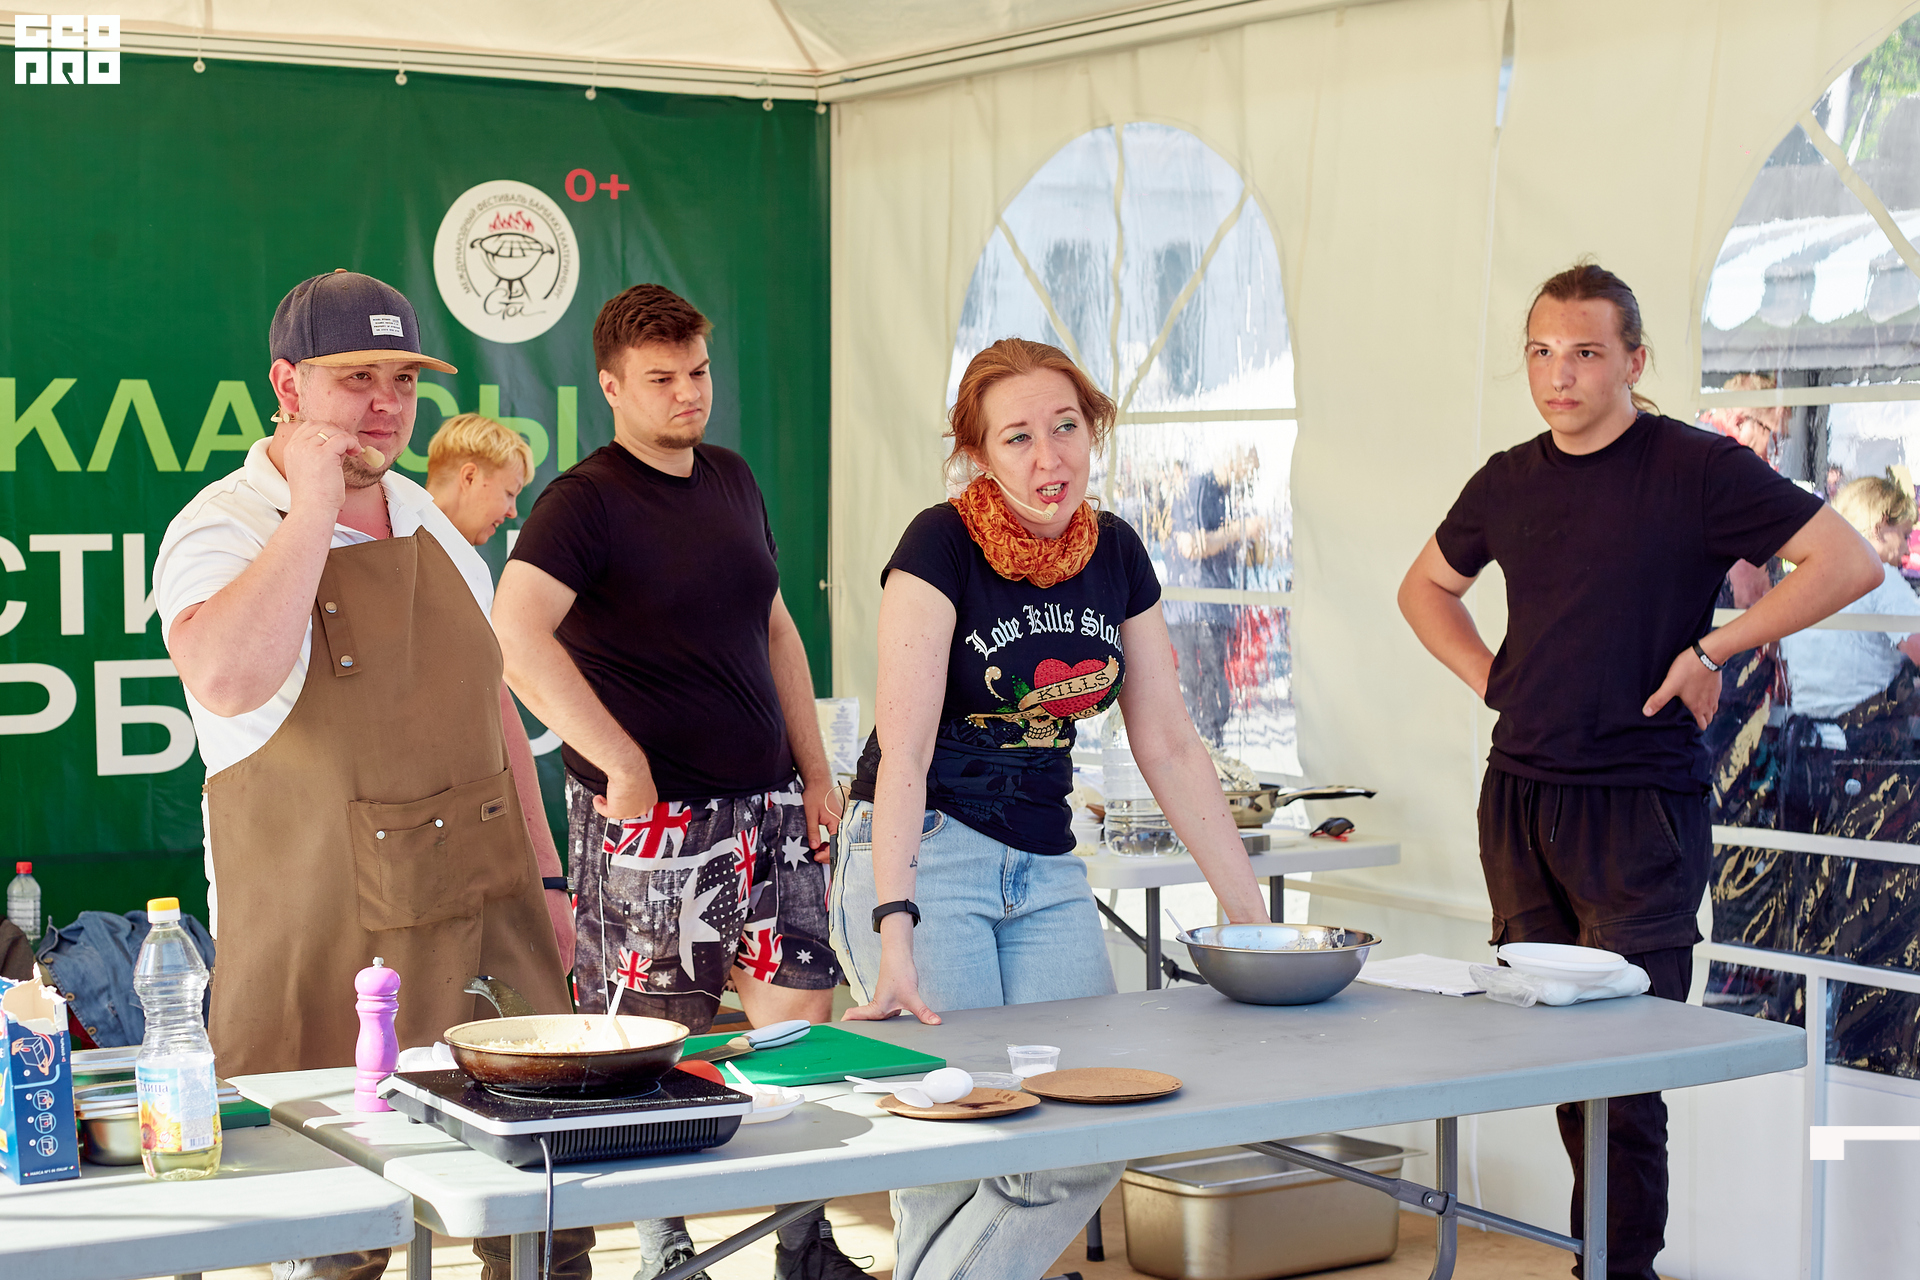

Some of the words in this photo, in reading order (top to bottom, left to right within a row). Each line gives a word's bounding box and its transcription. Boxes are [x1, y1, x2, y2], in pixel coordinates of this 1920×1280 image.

[565, 168, 630, 203] 0+
[476, 193, 528, 212] ФЕСТИВАЛЬ
[965, 616, 1024, 661] Love
[1022, 602, 1075, 635] Kills
[1036, 670, 1111, 702] KILLS
